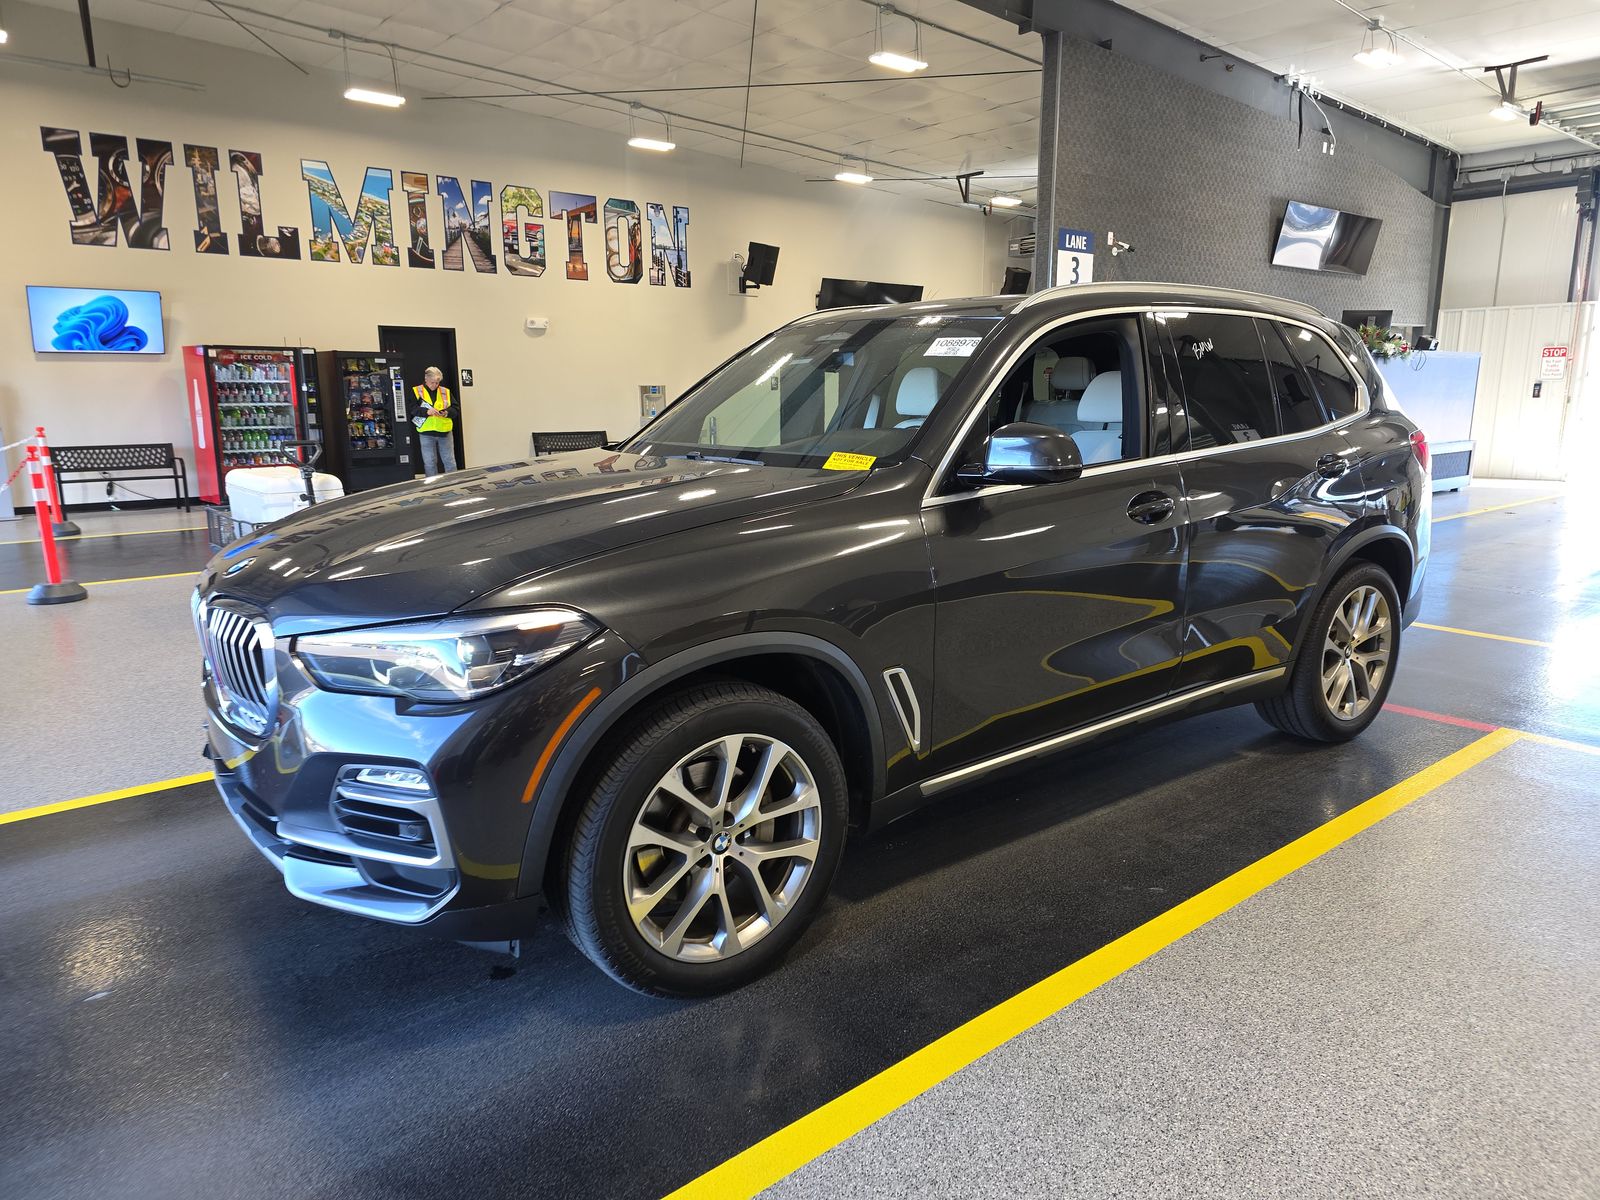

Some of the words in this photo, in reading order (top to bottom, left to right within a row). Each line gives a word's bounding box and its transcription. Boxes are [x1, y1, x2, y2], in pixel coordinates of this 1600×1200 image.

[40, 126, 692, 288] WILMINGTON
[1065, 234, 1087, 250] LANE
[1070, 256, 1080, 285] 3
[935, 339, 980, 347] 1088978
[1543, 348, 1566, 357] STOP
